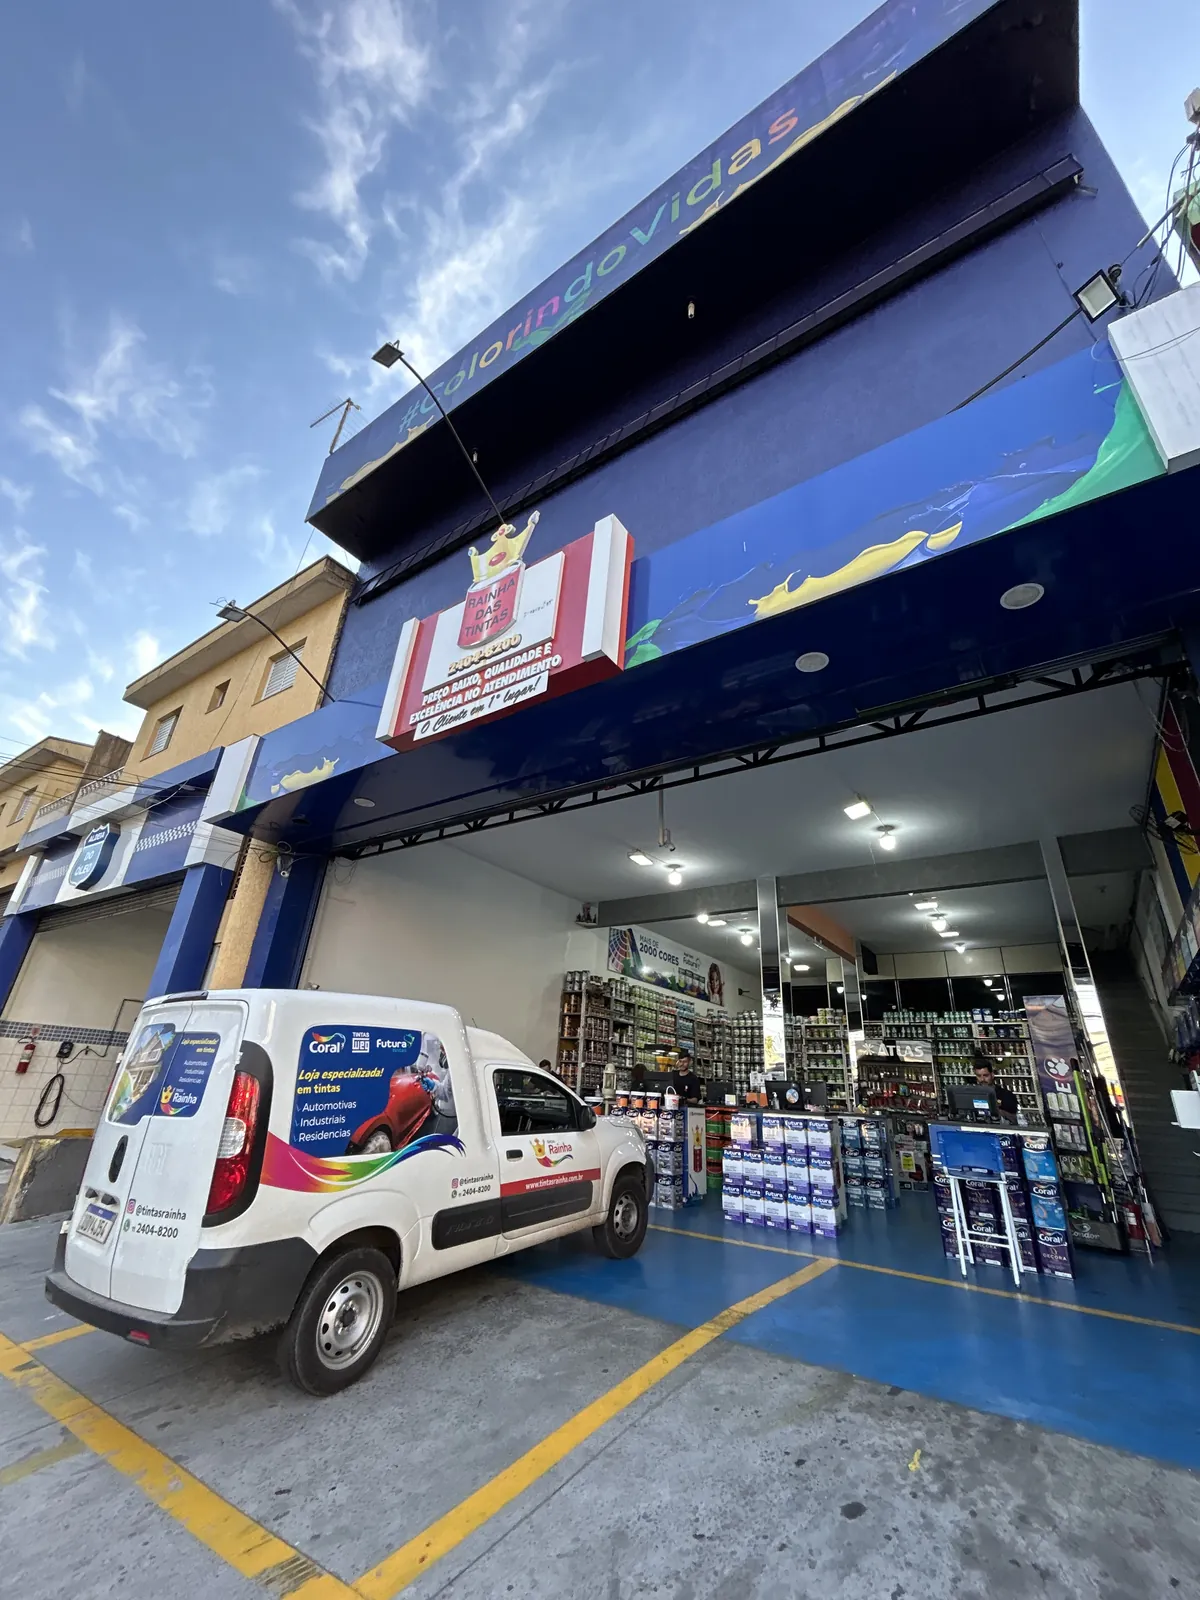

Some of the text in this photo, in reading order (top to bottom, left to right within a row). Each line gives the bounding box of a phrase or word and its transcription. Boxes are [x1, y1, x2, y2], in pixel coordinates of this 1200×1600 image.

[467, 577, 515, 609] RAINHA
[475, 600, 502, 621] DAS
[465, 608, 509, 637] TINTAS
[449, 634, 521, 674] 2404-8200
[422, 642, 553, 706] PREÇO BAIXO, QUALIDADE E
[409, 654, 563, 725] EXCELÊNCIA NO ATENDIMENTO
[421, 720, 430, 735] O
[433, 706, 468, 732] Cliente
[470, 704, 485, 716] em
[84, 850, 95, 861] DO
[640, 935, 659, 949] MAIS DE
[640, 943, 657, 957] 2000
[659, 951, 679, 966] CORES
[309, 1041, 340, 1053] Coral
[877, 1041, 924, 1057] ATLAS
[298, 1068, 384, 1082] Loja especializada!
[297, 1084, 341, 1094] em tintas
[172, 1092, 198, 1104] Rainha
[302, 1101, 356, 1112] Automotivas
[300, 1115, 346, 1127] Industriais
[298, 1129, 351, 1142] Residencias
[549, 1142, 573, 1155] Rainha
[1024, 1142, 1045, 1150] Coral
[459, 1174, 494, 1187] @tintasrainha
[525, 1174, 583, 1190] www.tintasrainha.com.br
[934, 1175, 951, 1184] Cora
[965, 1179, 984, 1188] Coral
[462, 1185, 491, 1197] 2404-8200
[1033, 1186, 1053, 1196] Coral
[136, 1205, 187, 1220] @tintasrainha
[942, 1219, 956, 1228] Cor
[972, 1223, 991, 1233] Coral
[136, 1223, 178, 1238] 2404-8200
[1039, 1234, 1060, 1243] Coral
